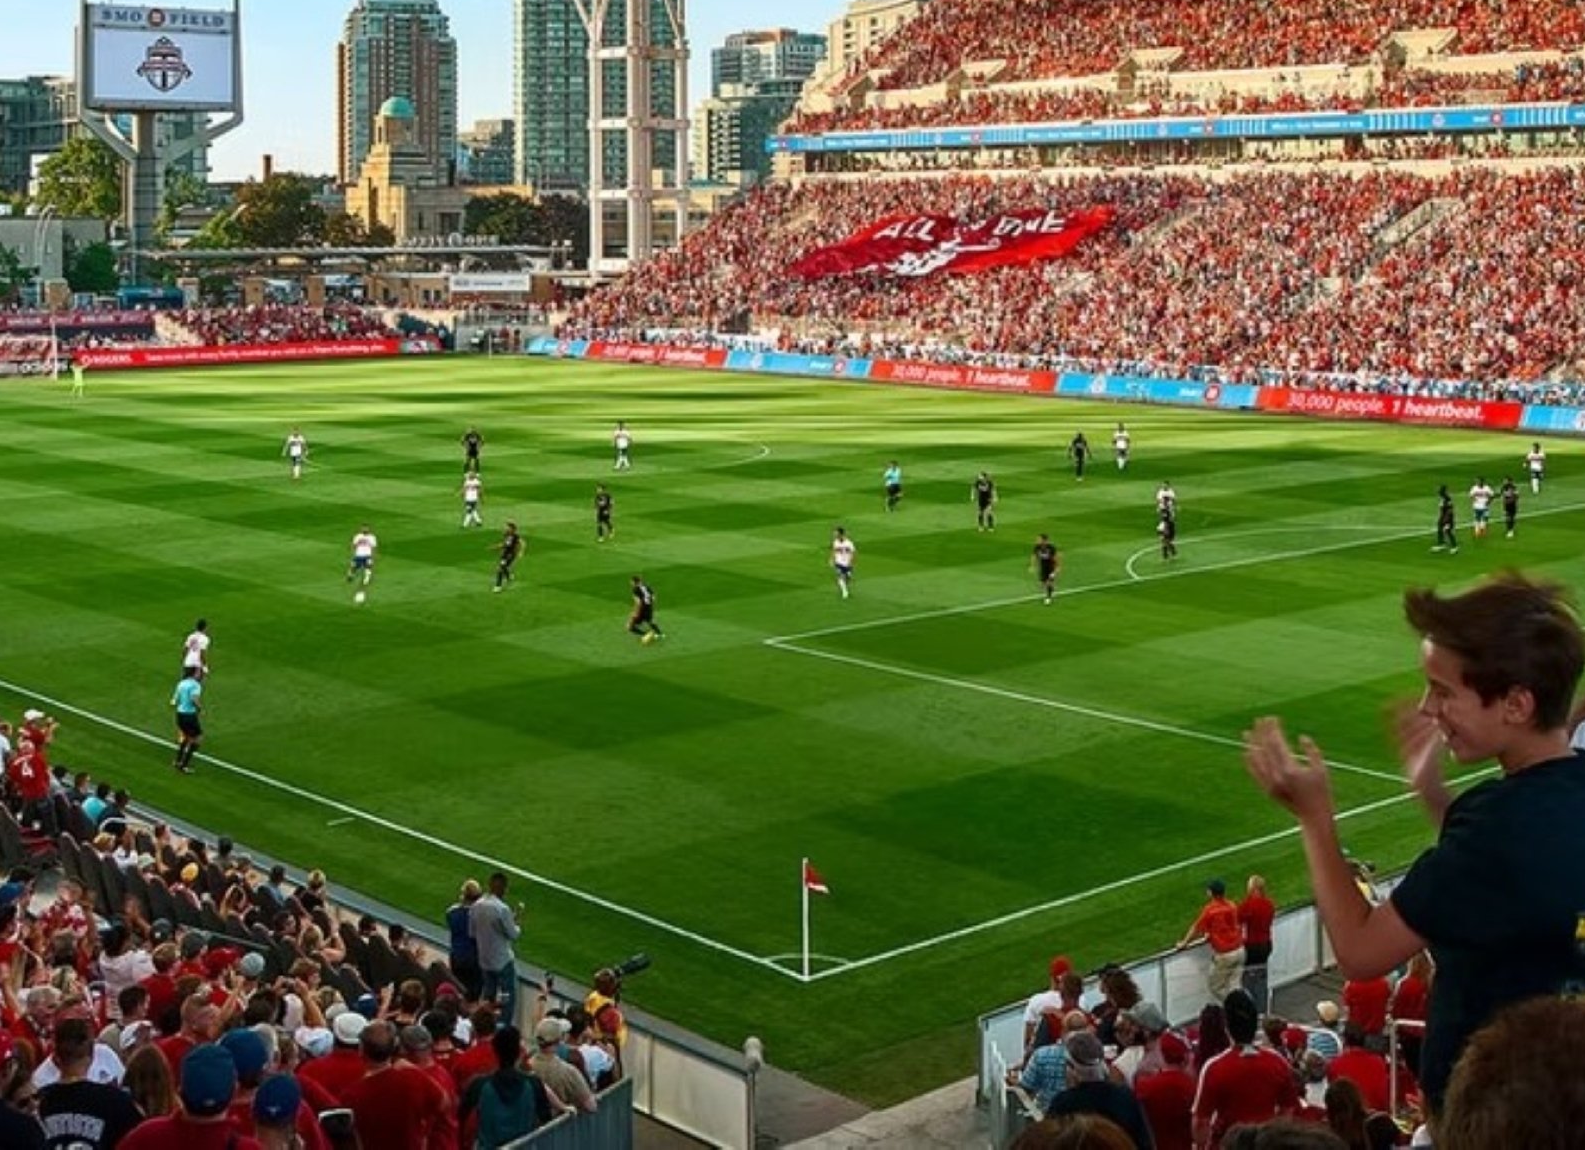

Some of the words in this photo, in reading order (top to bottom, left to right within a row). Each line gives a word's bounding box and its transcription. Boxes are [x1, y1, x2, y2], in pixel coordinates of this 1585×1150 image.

[101, 10, 143, 22] BMO
[170, 12, 225, 27] FIELD
[873, 216, 936, 241] ALL
[1286, 393, 1333, 412] 30,000
[1335, 397, 1385, 417] people.
[1392, 400, 1401, 414] 1
[1405, 400, 1485, 421] heartbeat.
